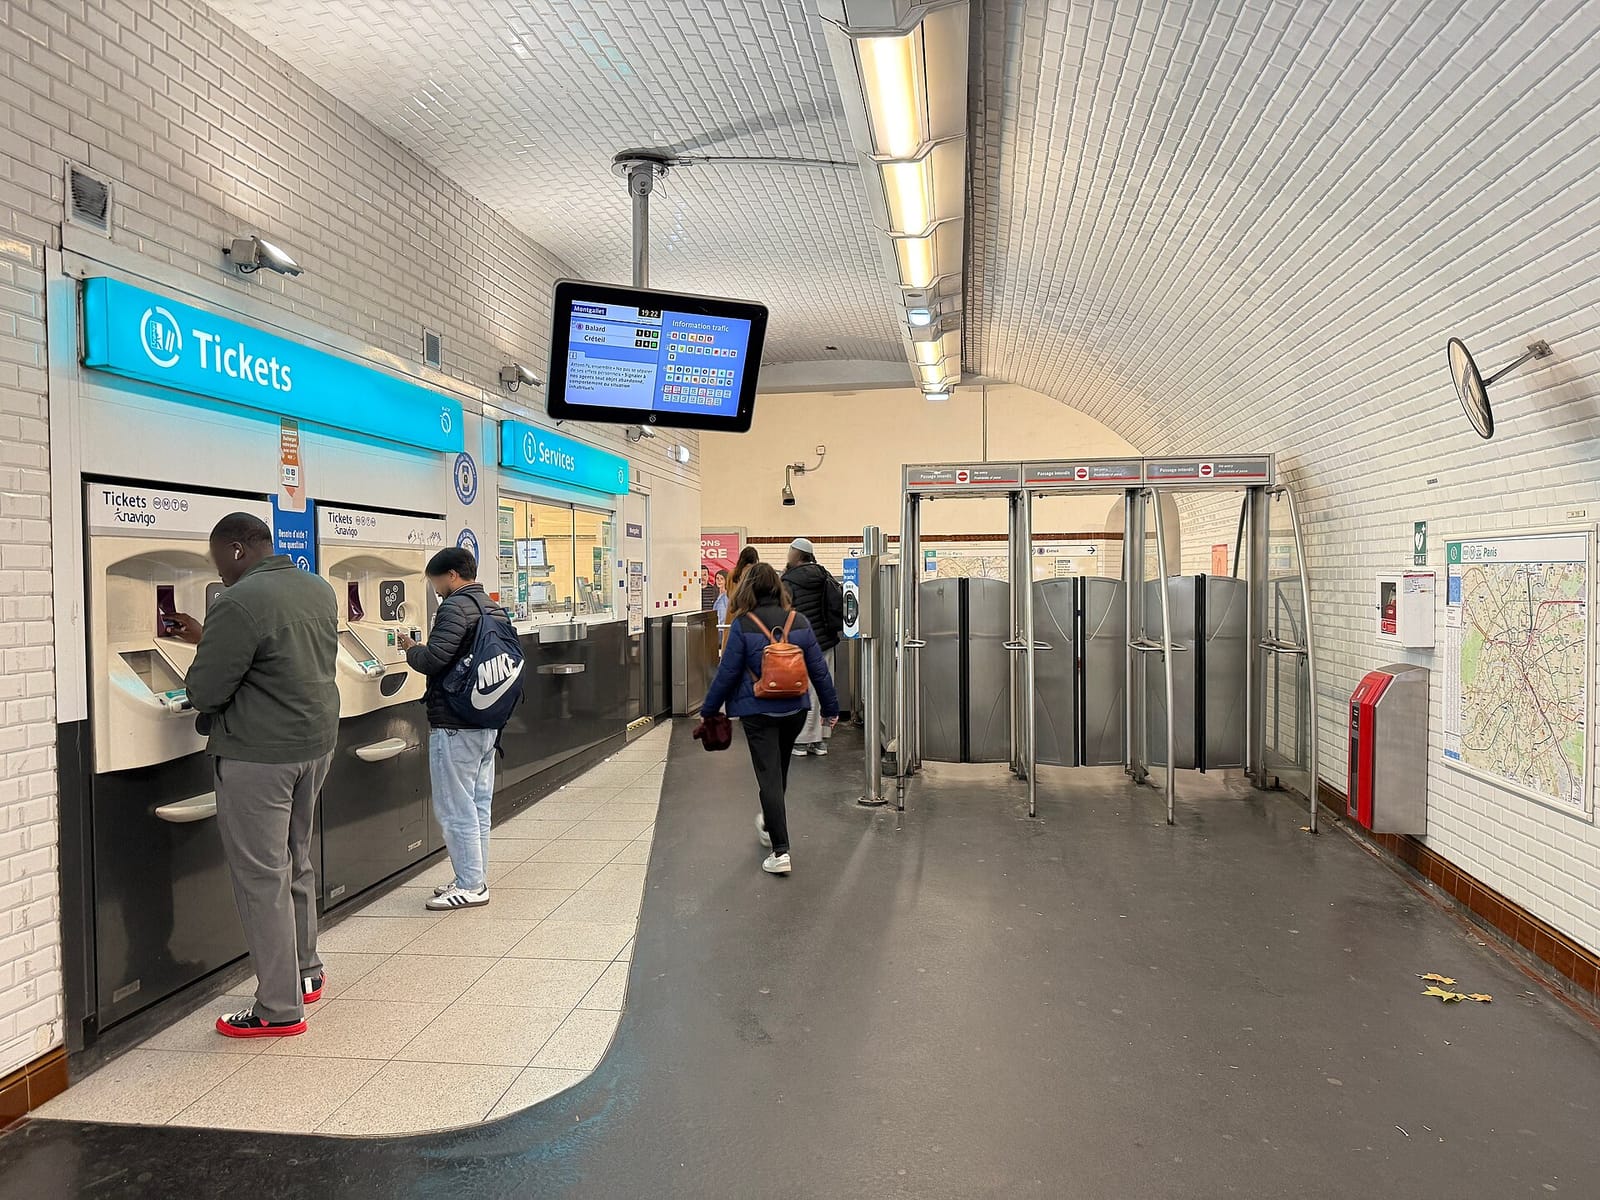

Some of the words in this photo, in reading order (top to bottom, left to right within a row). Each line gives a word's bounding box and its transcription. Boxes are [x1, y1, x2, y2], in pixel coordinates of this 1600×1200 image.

[574, 305, 605, 315] Montgallet
[585, 324, 606, 332] Balard
[672, 320, 711, 330] Information
[584, 334, 606, 343] Créteil
[192, 329, 292, 392] Tickets
[539, 442, 575, 471] Services
[103, 491, 147, 509] Tickets
[119, 510, 156, 526] navigo
[328, 512, 353, 525] Tickets
[1483, 547, 1497, 557] Paris
